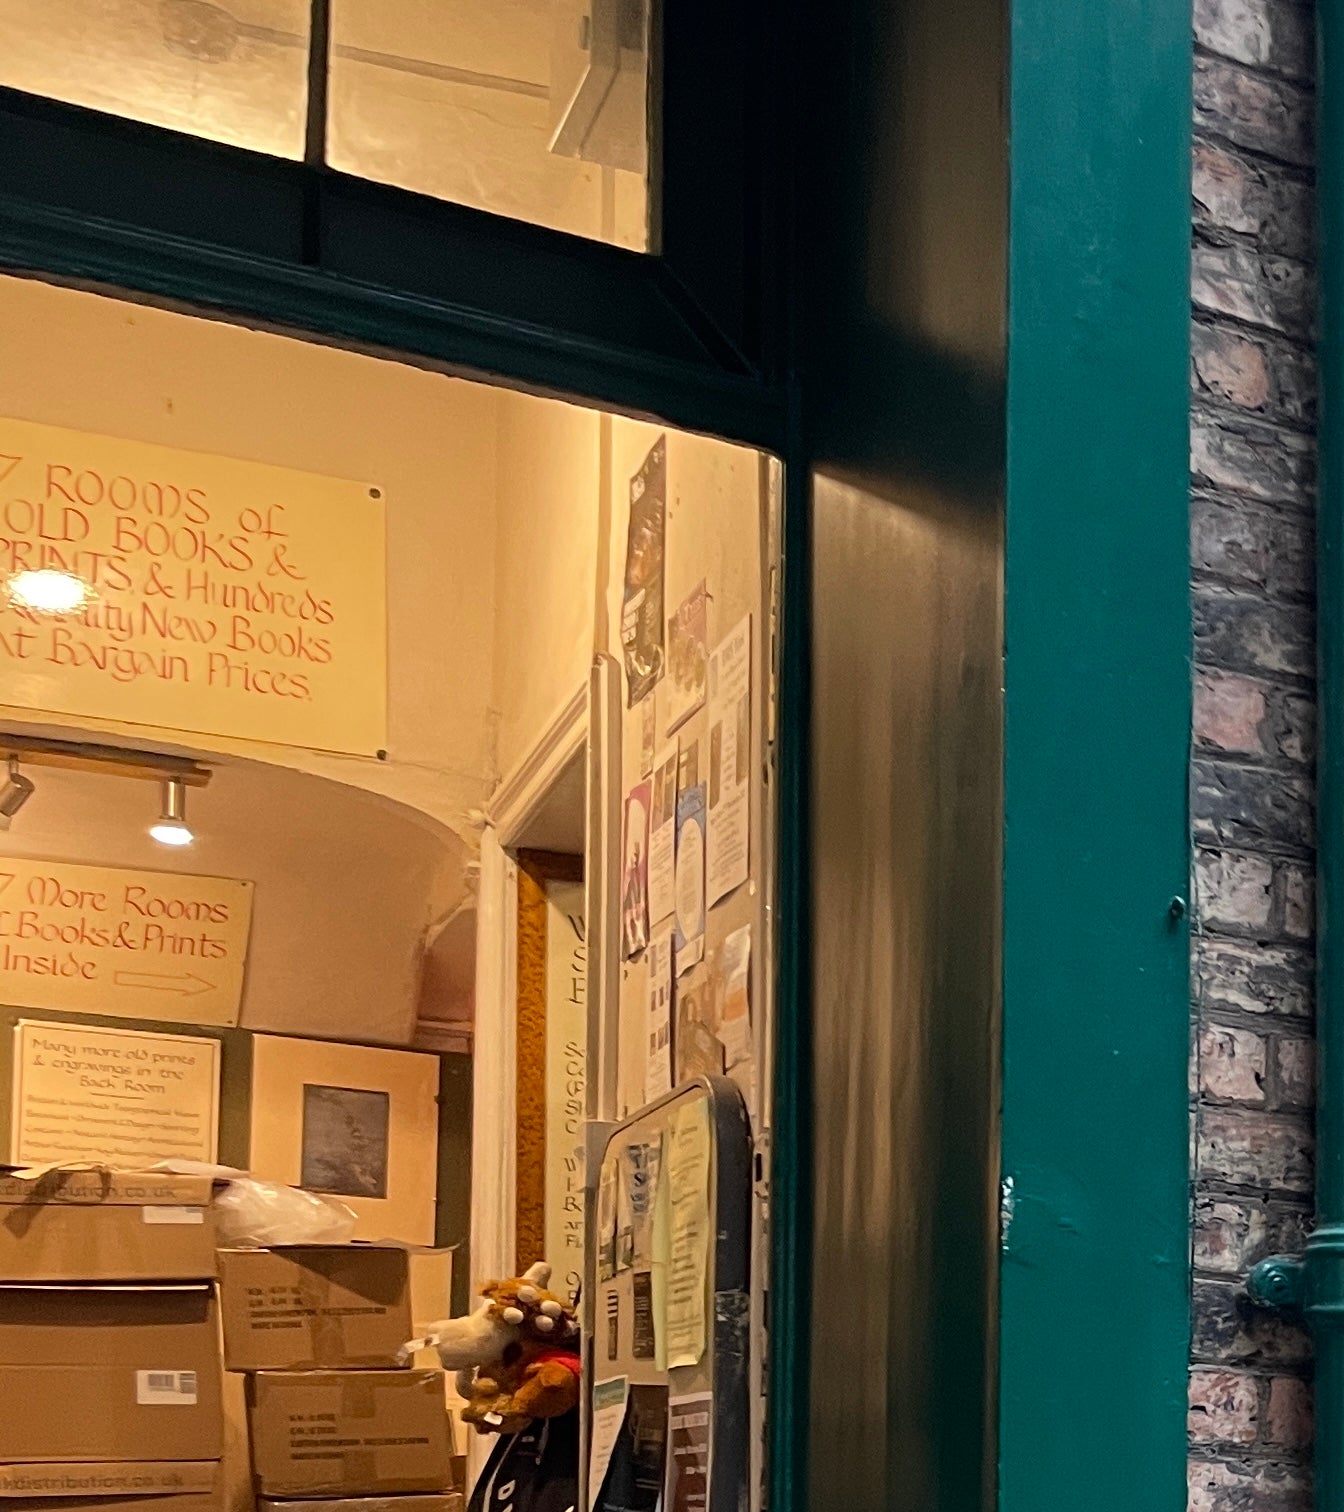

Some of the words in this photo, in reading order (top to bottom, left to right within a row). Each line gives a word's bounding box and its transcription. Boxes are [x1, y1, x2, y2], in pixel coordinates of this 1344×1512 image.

[46, 464, 210, 524] ROOMS
[239, 504, 289, 540] of
[4, 499, 90, 543] OLD
[112, 516, 253, 571] BOOKS
[267, 544, 308, 580] &
[145, 562, 175, 599] &
[46, 627, 190, 683] Bargain
[142, 601, 217, 644] New
[227, 615, 333, 664] Books
[27, 876, 107, 912] More
[124, 885, 229, 923] Rooms
[15, 910, 111, 948] Books
[112, 920, 137, 950] &
[143, 923, 228, 959] Prints
[3, 944, 97, 980] Inside
